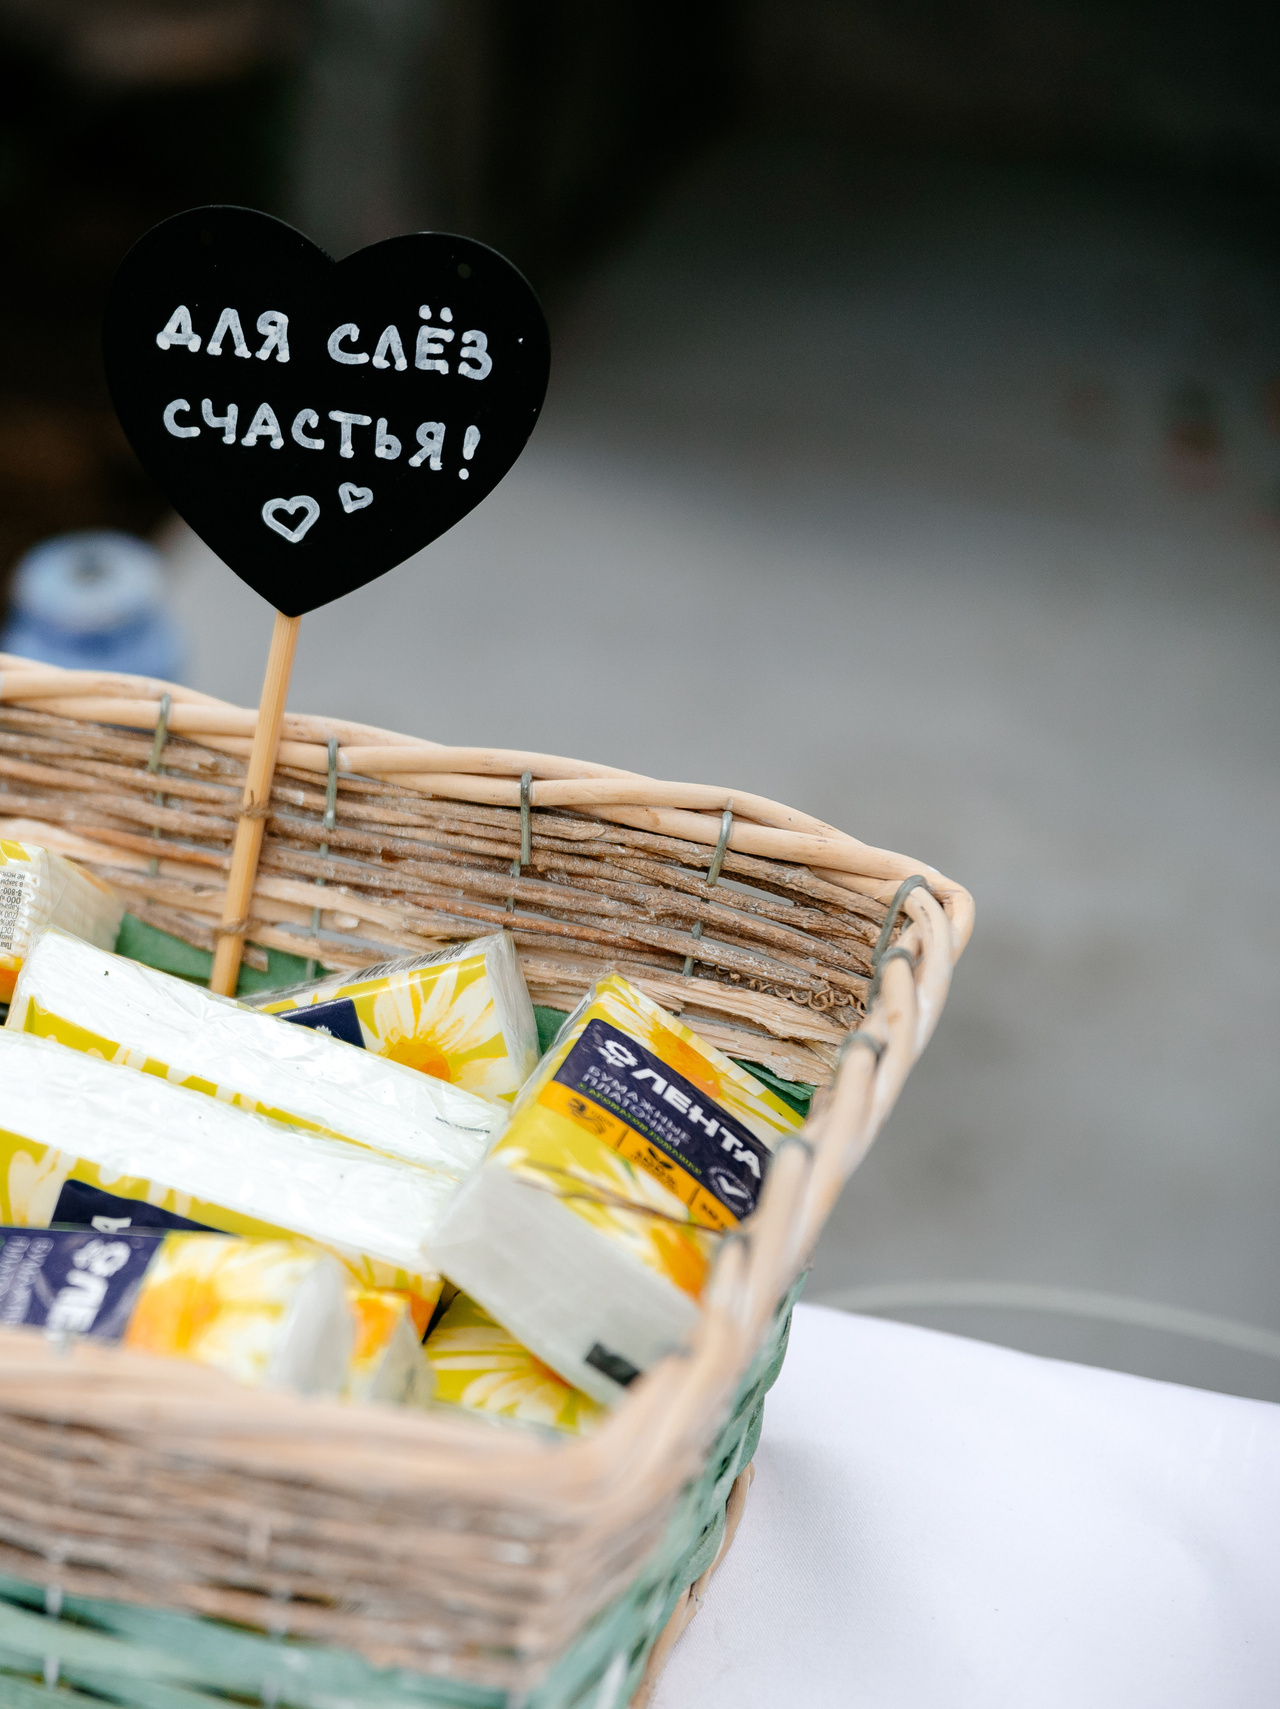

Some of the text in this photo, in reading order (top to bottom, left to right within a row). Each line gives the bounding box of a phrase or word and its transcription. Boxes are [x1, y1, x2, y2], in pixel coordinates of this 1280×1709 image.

[156, 304, 493, 380] ДЛЯ СЛЁЗ
[163, 398, 481, 480] СЧАСТЬЯ!
[631, 1068, 761, 1178] ЛЕНТА
